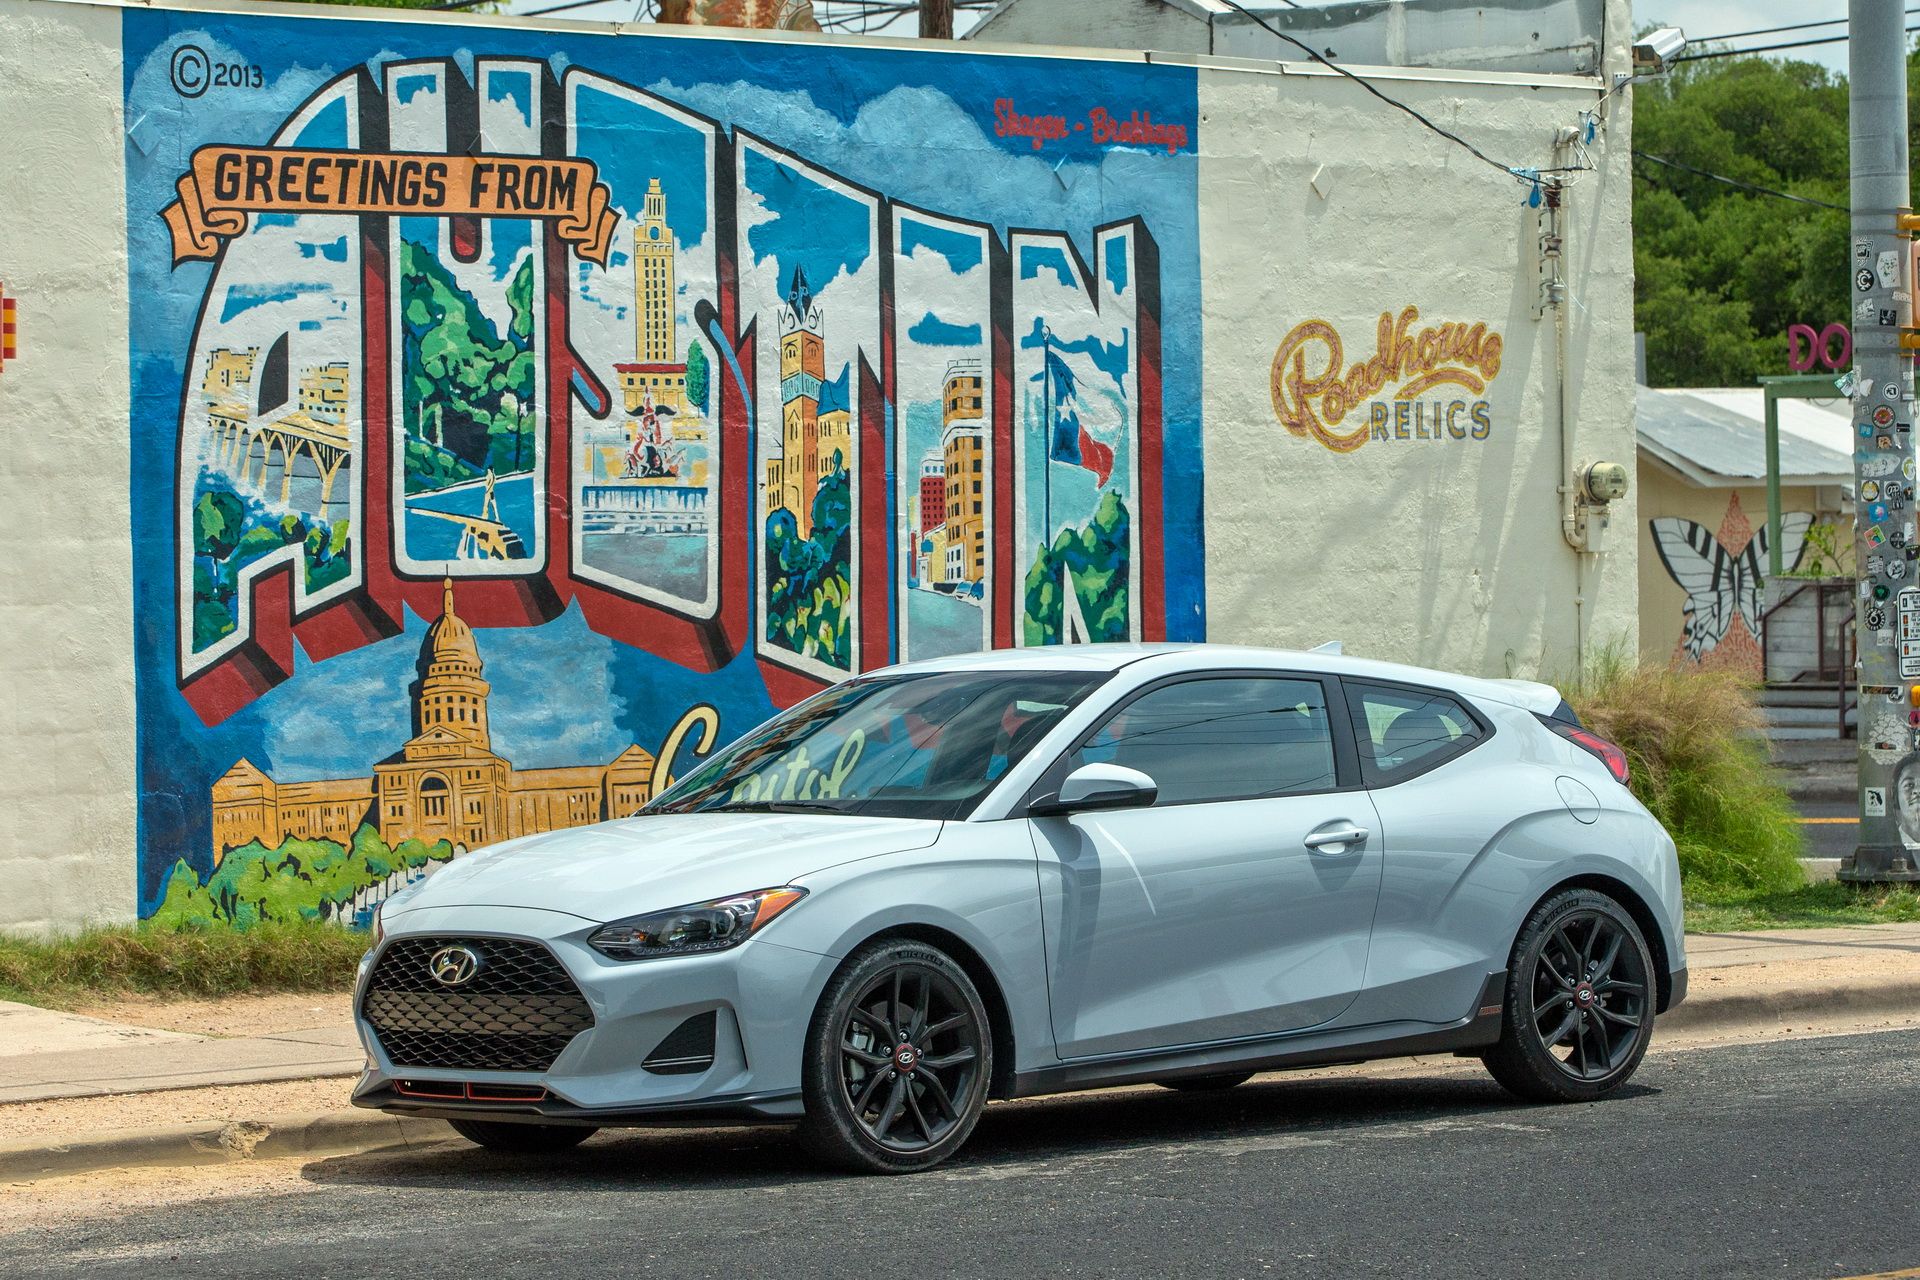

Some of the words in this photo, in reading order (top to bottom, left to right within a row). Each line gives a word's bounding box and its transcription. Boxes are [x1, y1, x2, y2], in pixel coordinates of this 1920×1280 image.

[214, 63, 264, 89] 2013
[215, 154, 448, 207] GREETINGS
[469, 162, 580, 212] FROM
[178, 58, 1150, 690] AUSTIN
[1271, 305, 1503, 453] Roadhouse
[1371, 400, 1491, 441] RELICS
